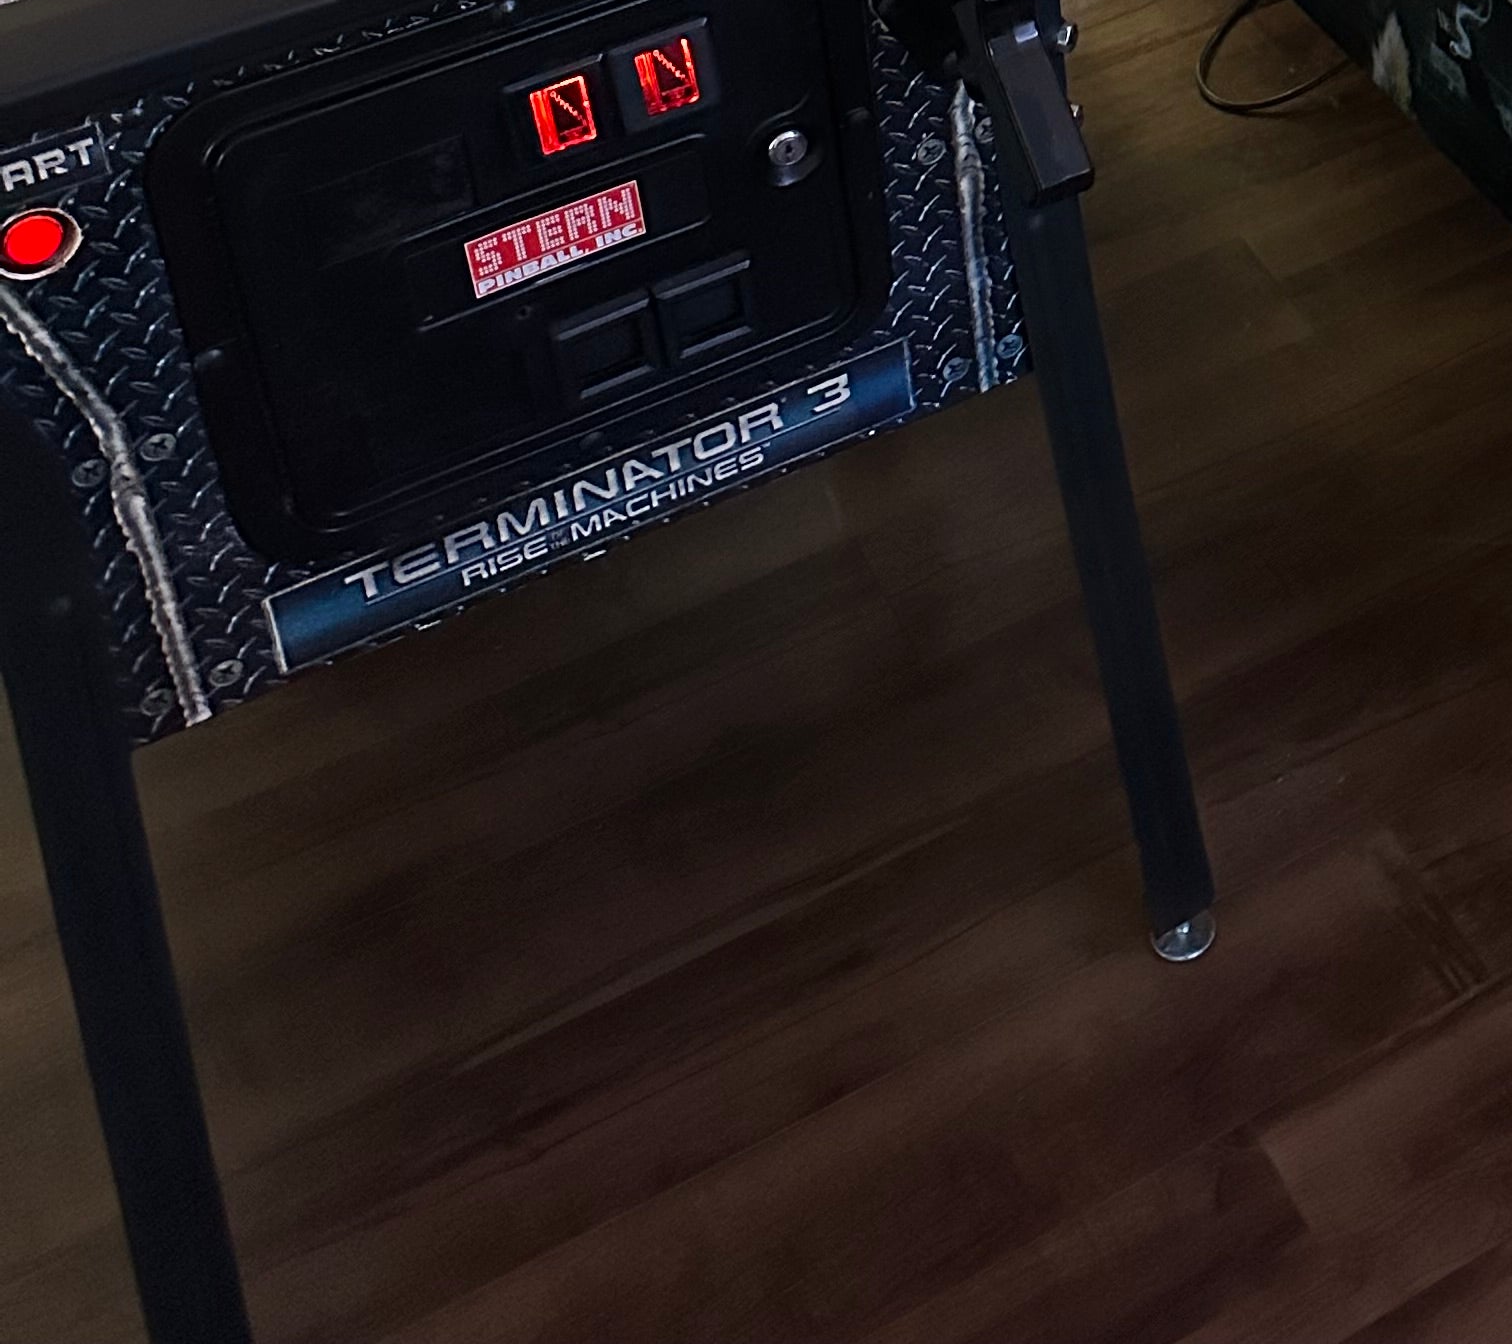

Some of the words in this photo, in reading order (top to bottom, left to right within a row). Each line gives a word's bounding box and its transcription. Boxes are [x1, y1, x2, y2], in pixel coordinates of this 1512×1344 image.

[474, 184, 637, 277] STERN
[477, 244, 590, 296] PINBALL,
[595, 222, 645, 249] INC.
[344, 400, 785, 600] TERMINATOR
[807, 372, 852, 413] 3
[461, 541, 548, 586] RISE
[571, 450, 765, 542] MACHINES
